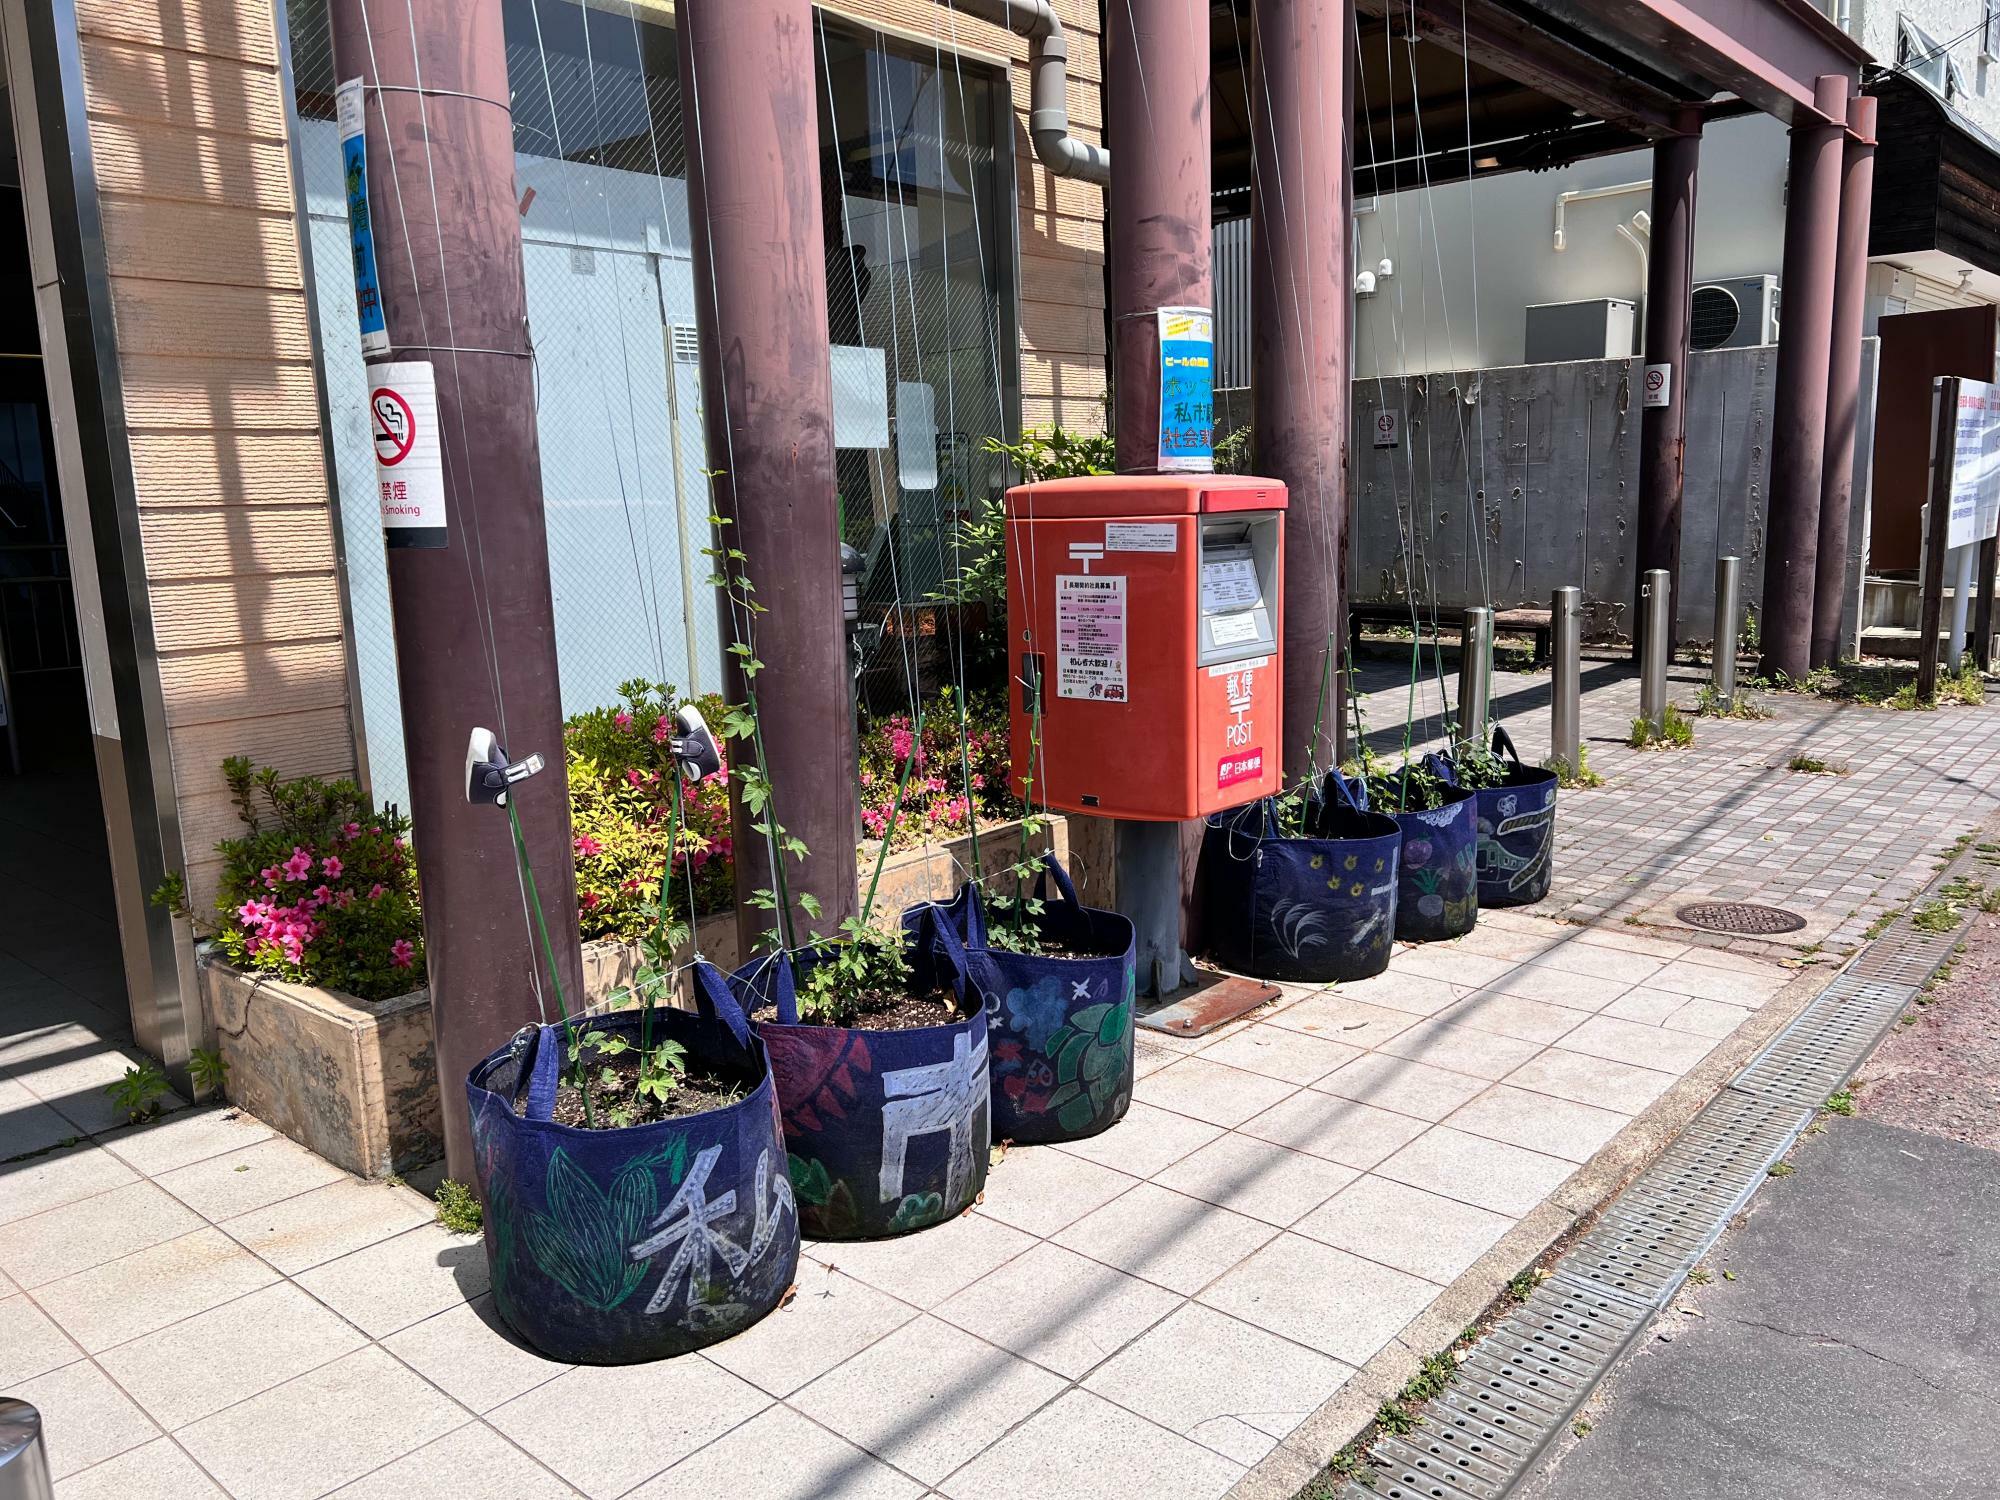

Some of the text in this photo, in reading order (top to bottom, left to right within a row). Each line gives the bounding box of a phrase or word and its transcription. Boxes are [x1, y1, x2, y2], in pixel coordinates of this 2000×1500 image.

[381, 481, 408, 501] 禁煙
[385, 504, 421, 517] Smoking
[1227, 670, 1254, 700] 郵便
[1227, 721, 1254, 749] POST
[1235, 756, 1261, 775] 日本郵便
